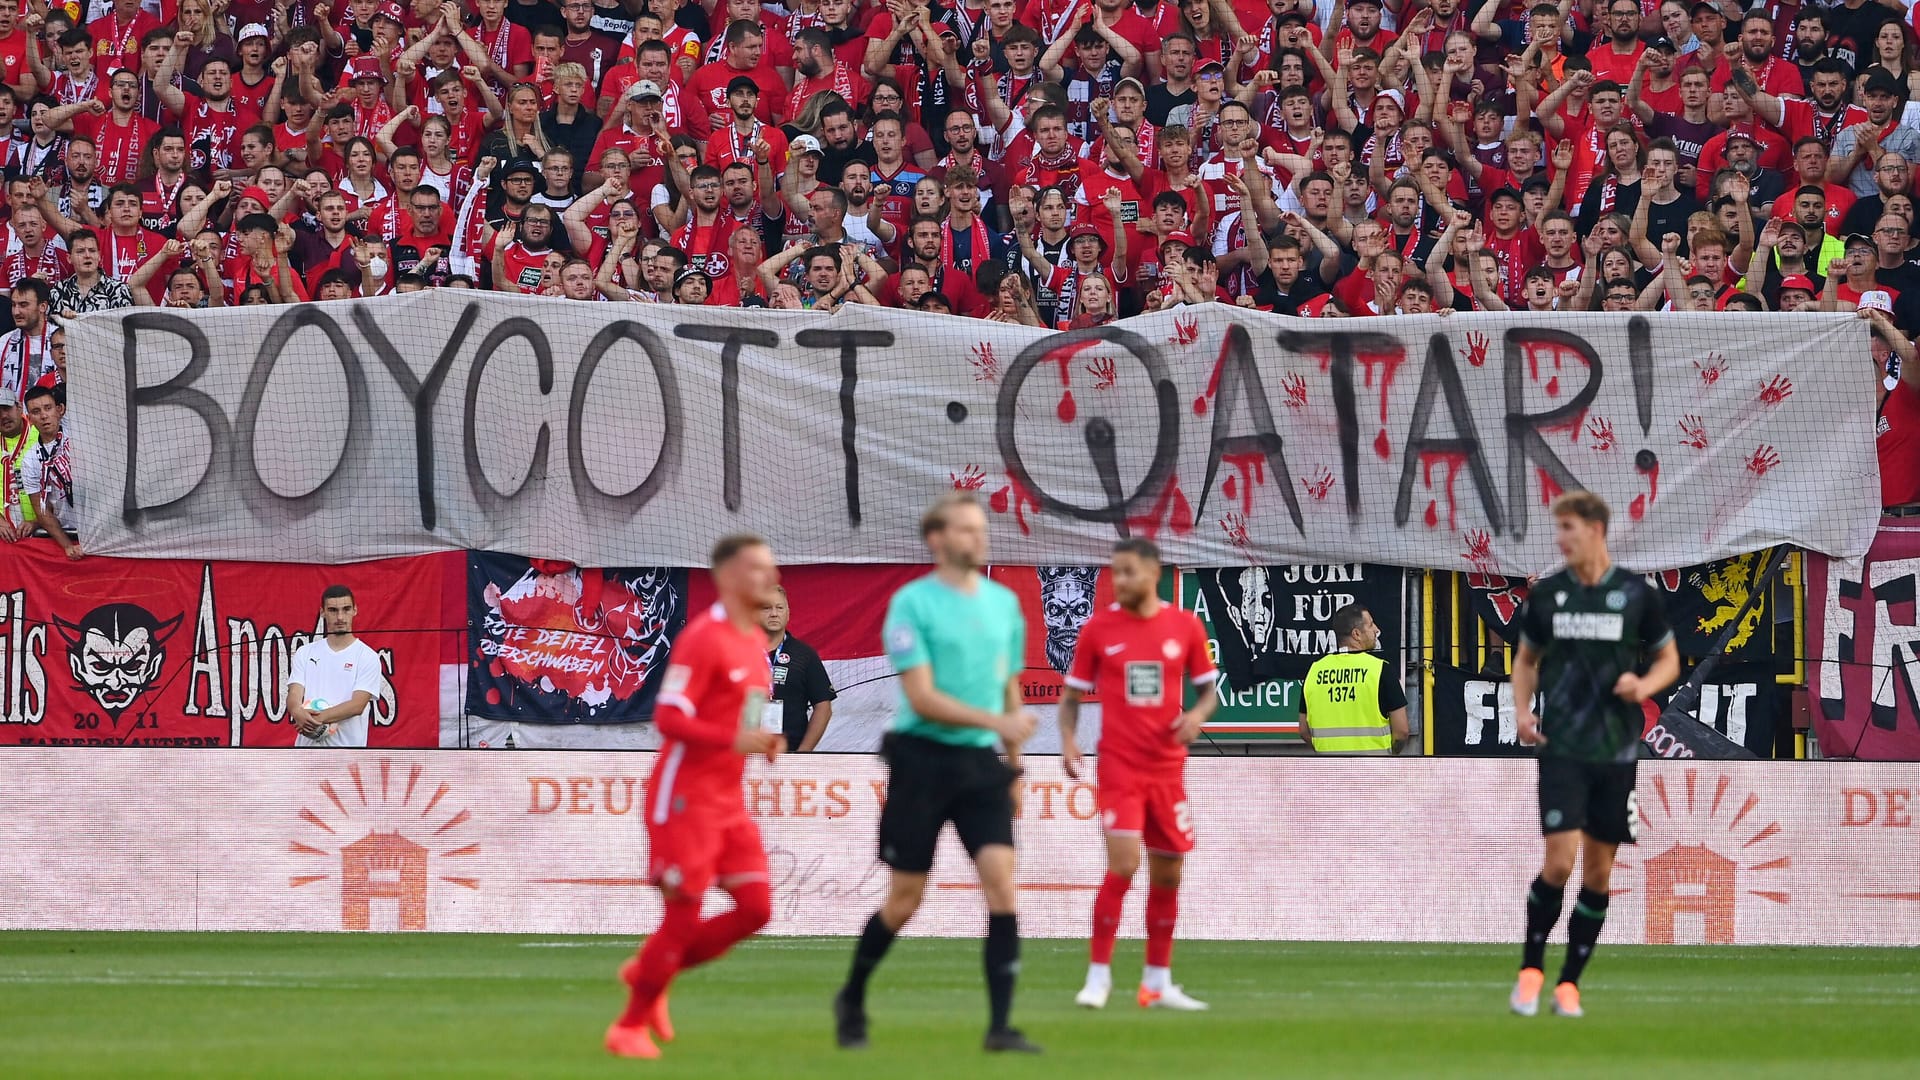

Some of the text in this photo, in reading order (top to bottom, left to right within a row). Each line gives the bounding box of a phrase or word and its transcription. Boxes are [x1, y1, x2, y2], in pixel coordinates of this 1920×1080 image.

[603, 18, 633, 31] Replay
[123, 303, 1658, 541] BOYCOTT QATAR!
[533, 627, 606, 655] DEIFEL
[1316, 667, 1369, 686] SECURITY
[1327, 686, 1356, 703] 1374
[526, 776, 852, 818] DEUHES
